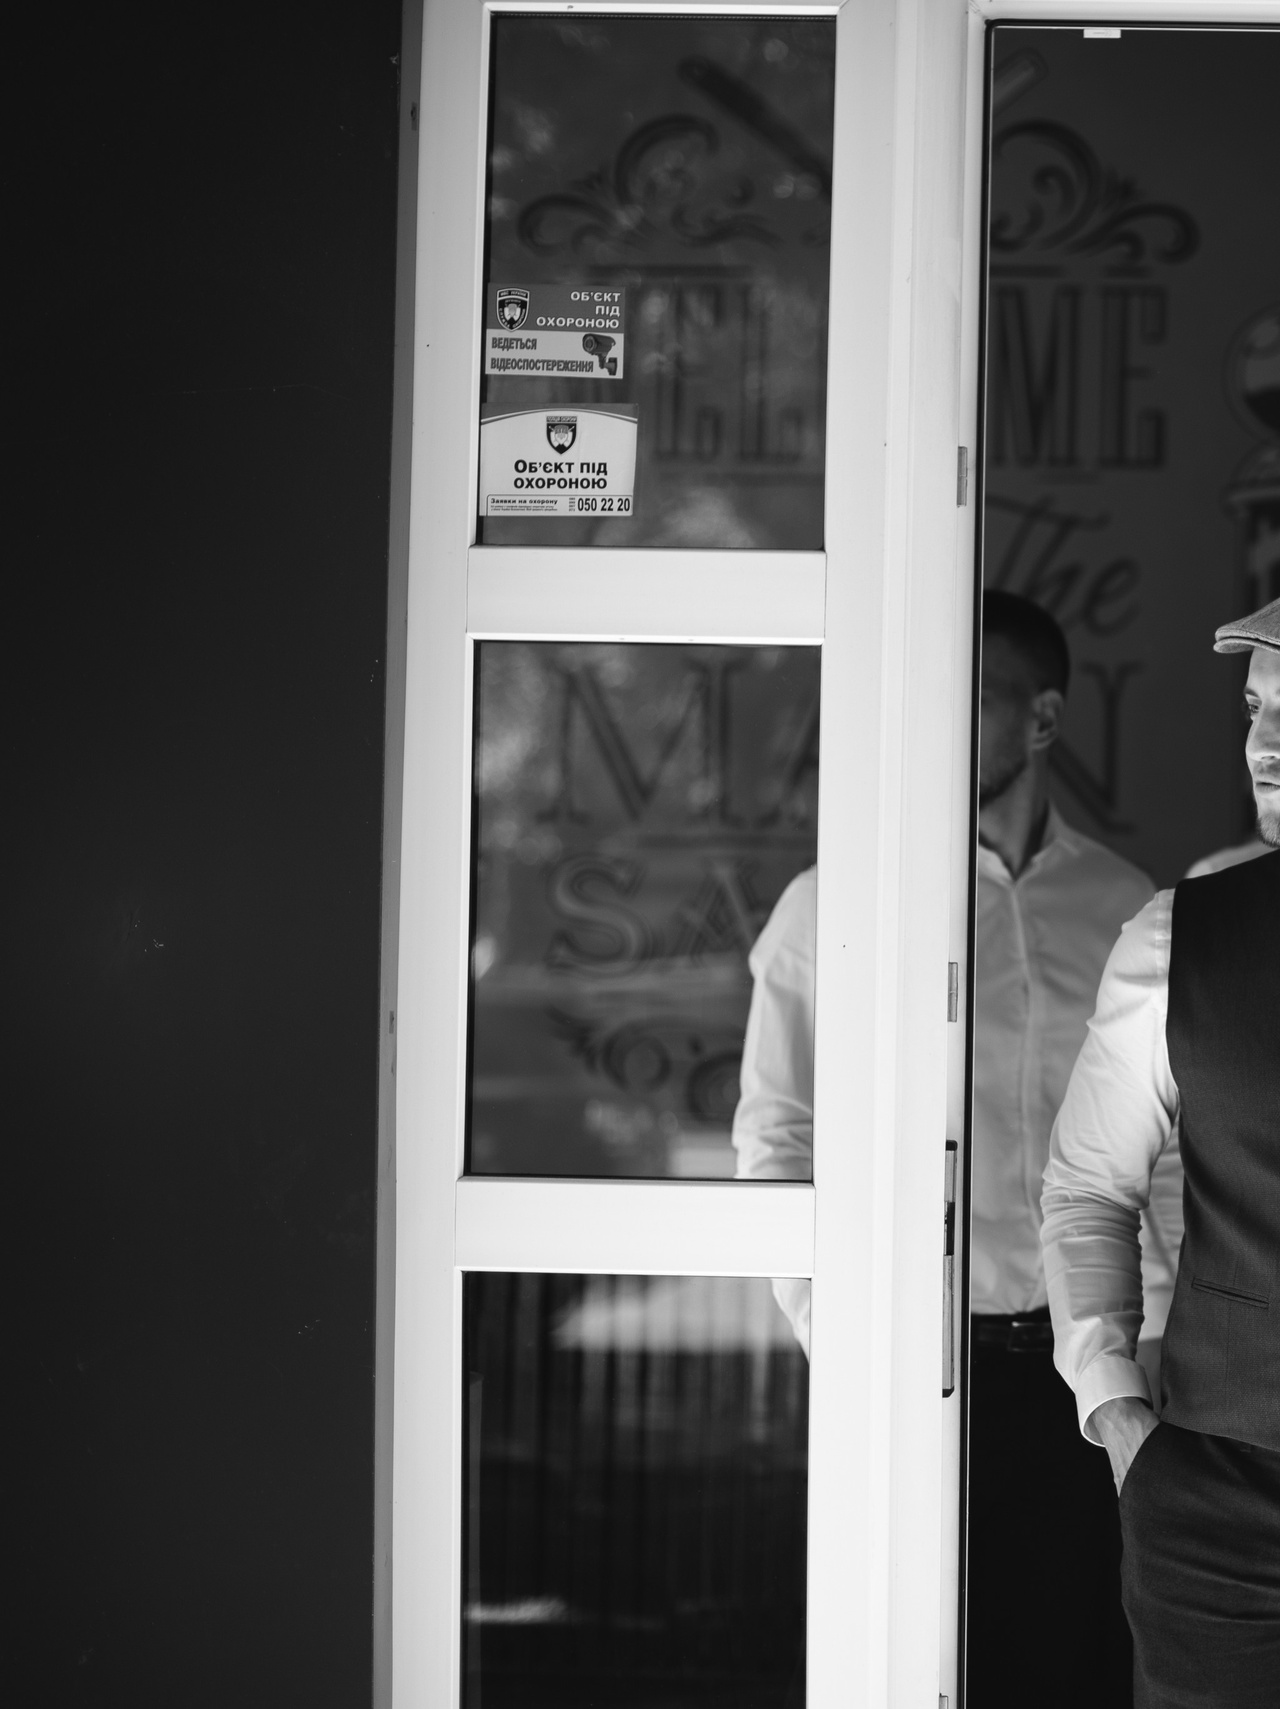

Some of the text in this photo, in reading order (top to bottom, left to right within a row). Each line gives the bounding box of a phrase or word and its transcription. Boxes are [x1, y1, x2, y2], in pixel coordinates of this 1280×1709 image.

[595, 305, 621, 317] ПІД
[536, 316, 620, 329] ОХОРОНОЮ
[491, 337, 537, 351] ВЕДЕТЬСЯ
[490, 357, 594, 373] ВІДЕОСПОСТЕРЕЖЕННЯ
[513, 477, 608, 489] ОХОРОНОЮ
[577, 497, 598, 512] 050
[600, 497, 614, 512] 22
[616, 497, 631, 512] 20
